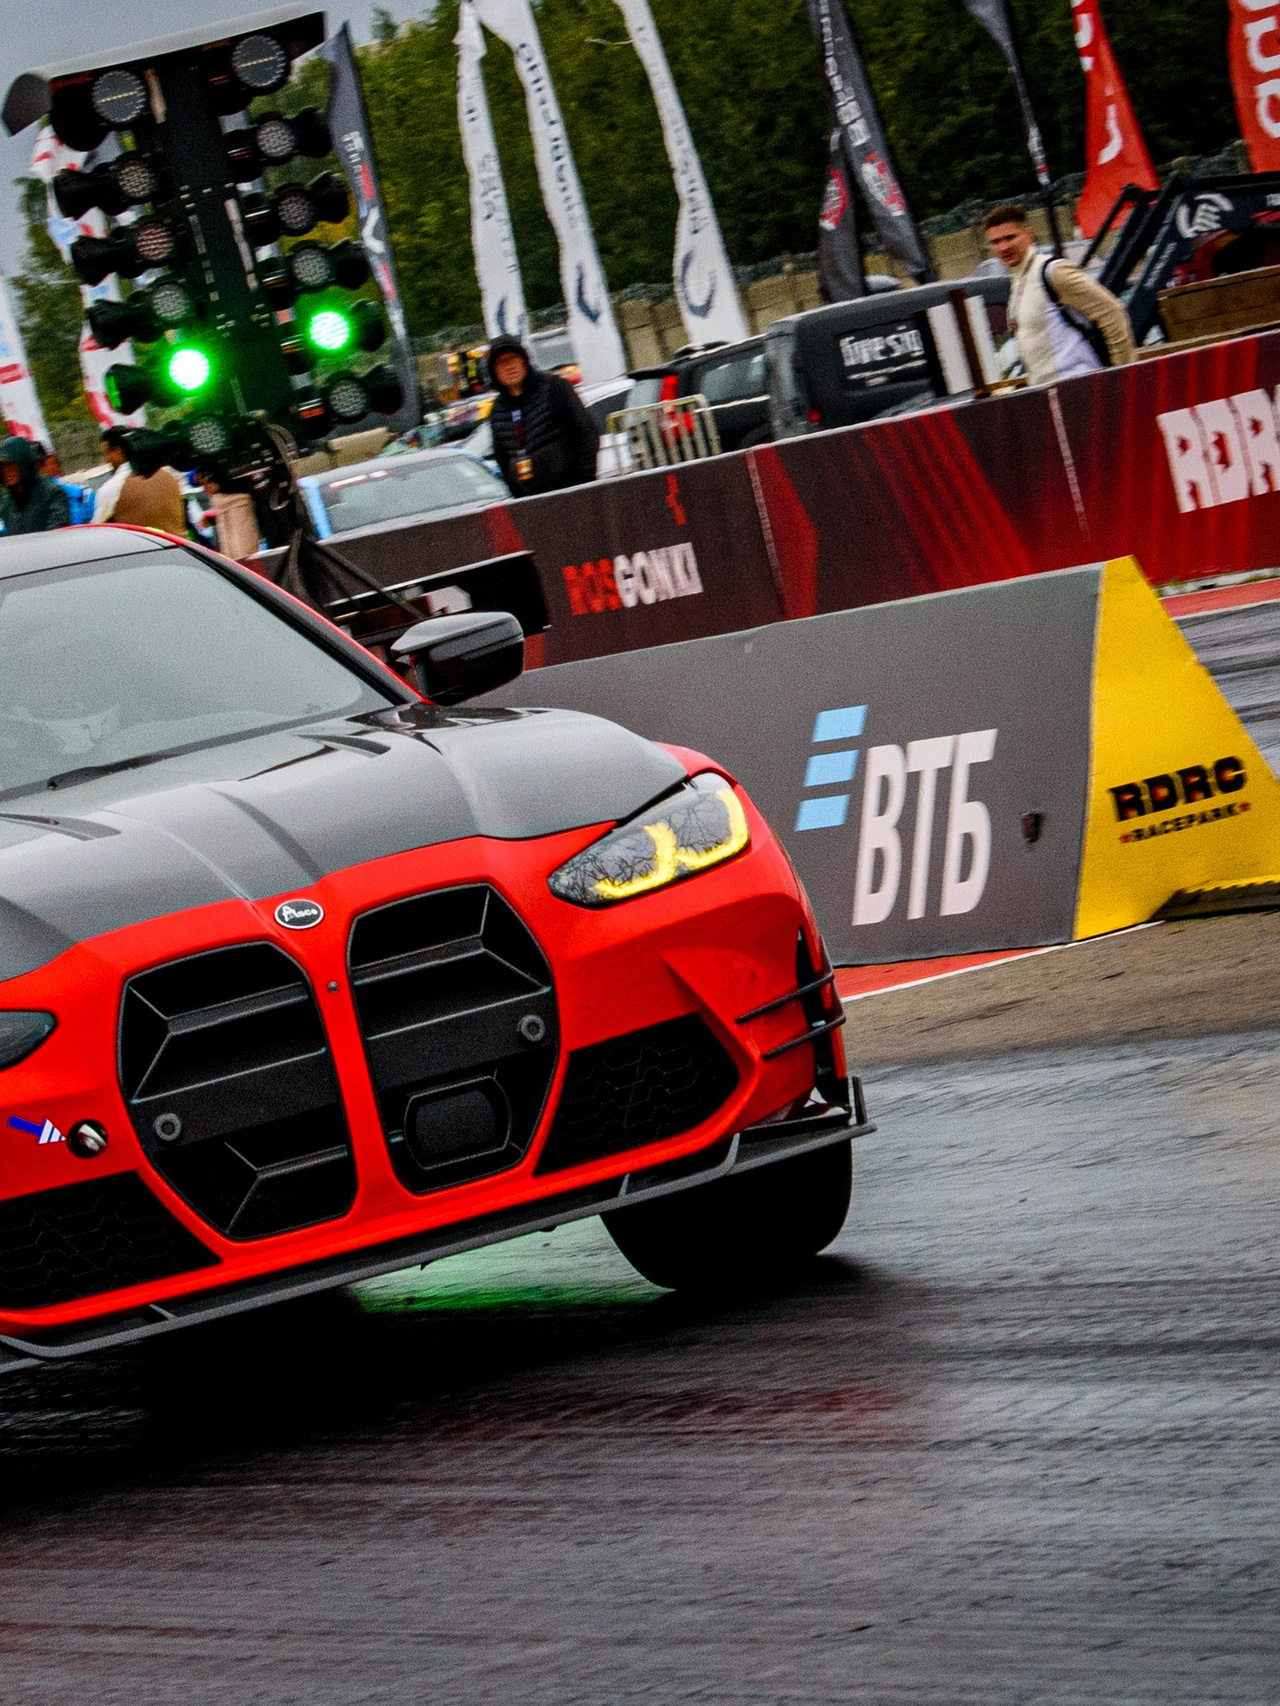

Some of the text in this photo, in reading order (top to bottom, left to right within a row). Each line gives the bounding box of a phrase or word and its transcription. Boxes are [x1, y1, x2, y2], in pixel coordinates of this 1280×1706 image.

[1156, 384, 1280, 514] RDR
[852, 728, 998, 926] ВТБ
[1107, 755, 1246, 822] RDRC
